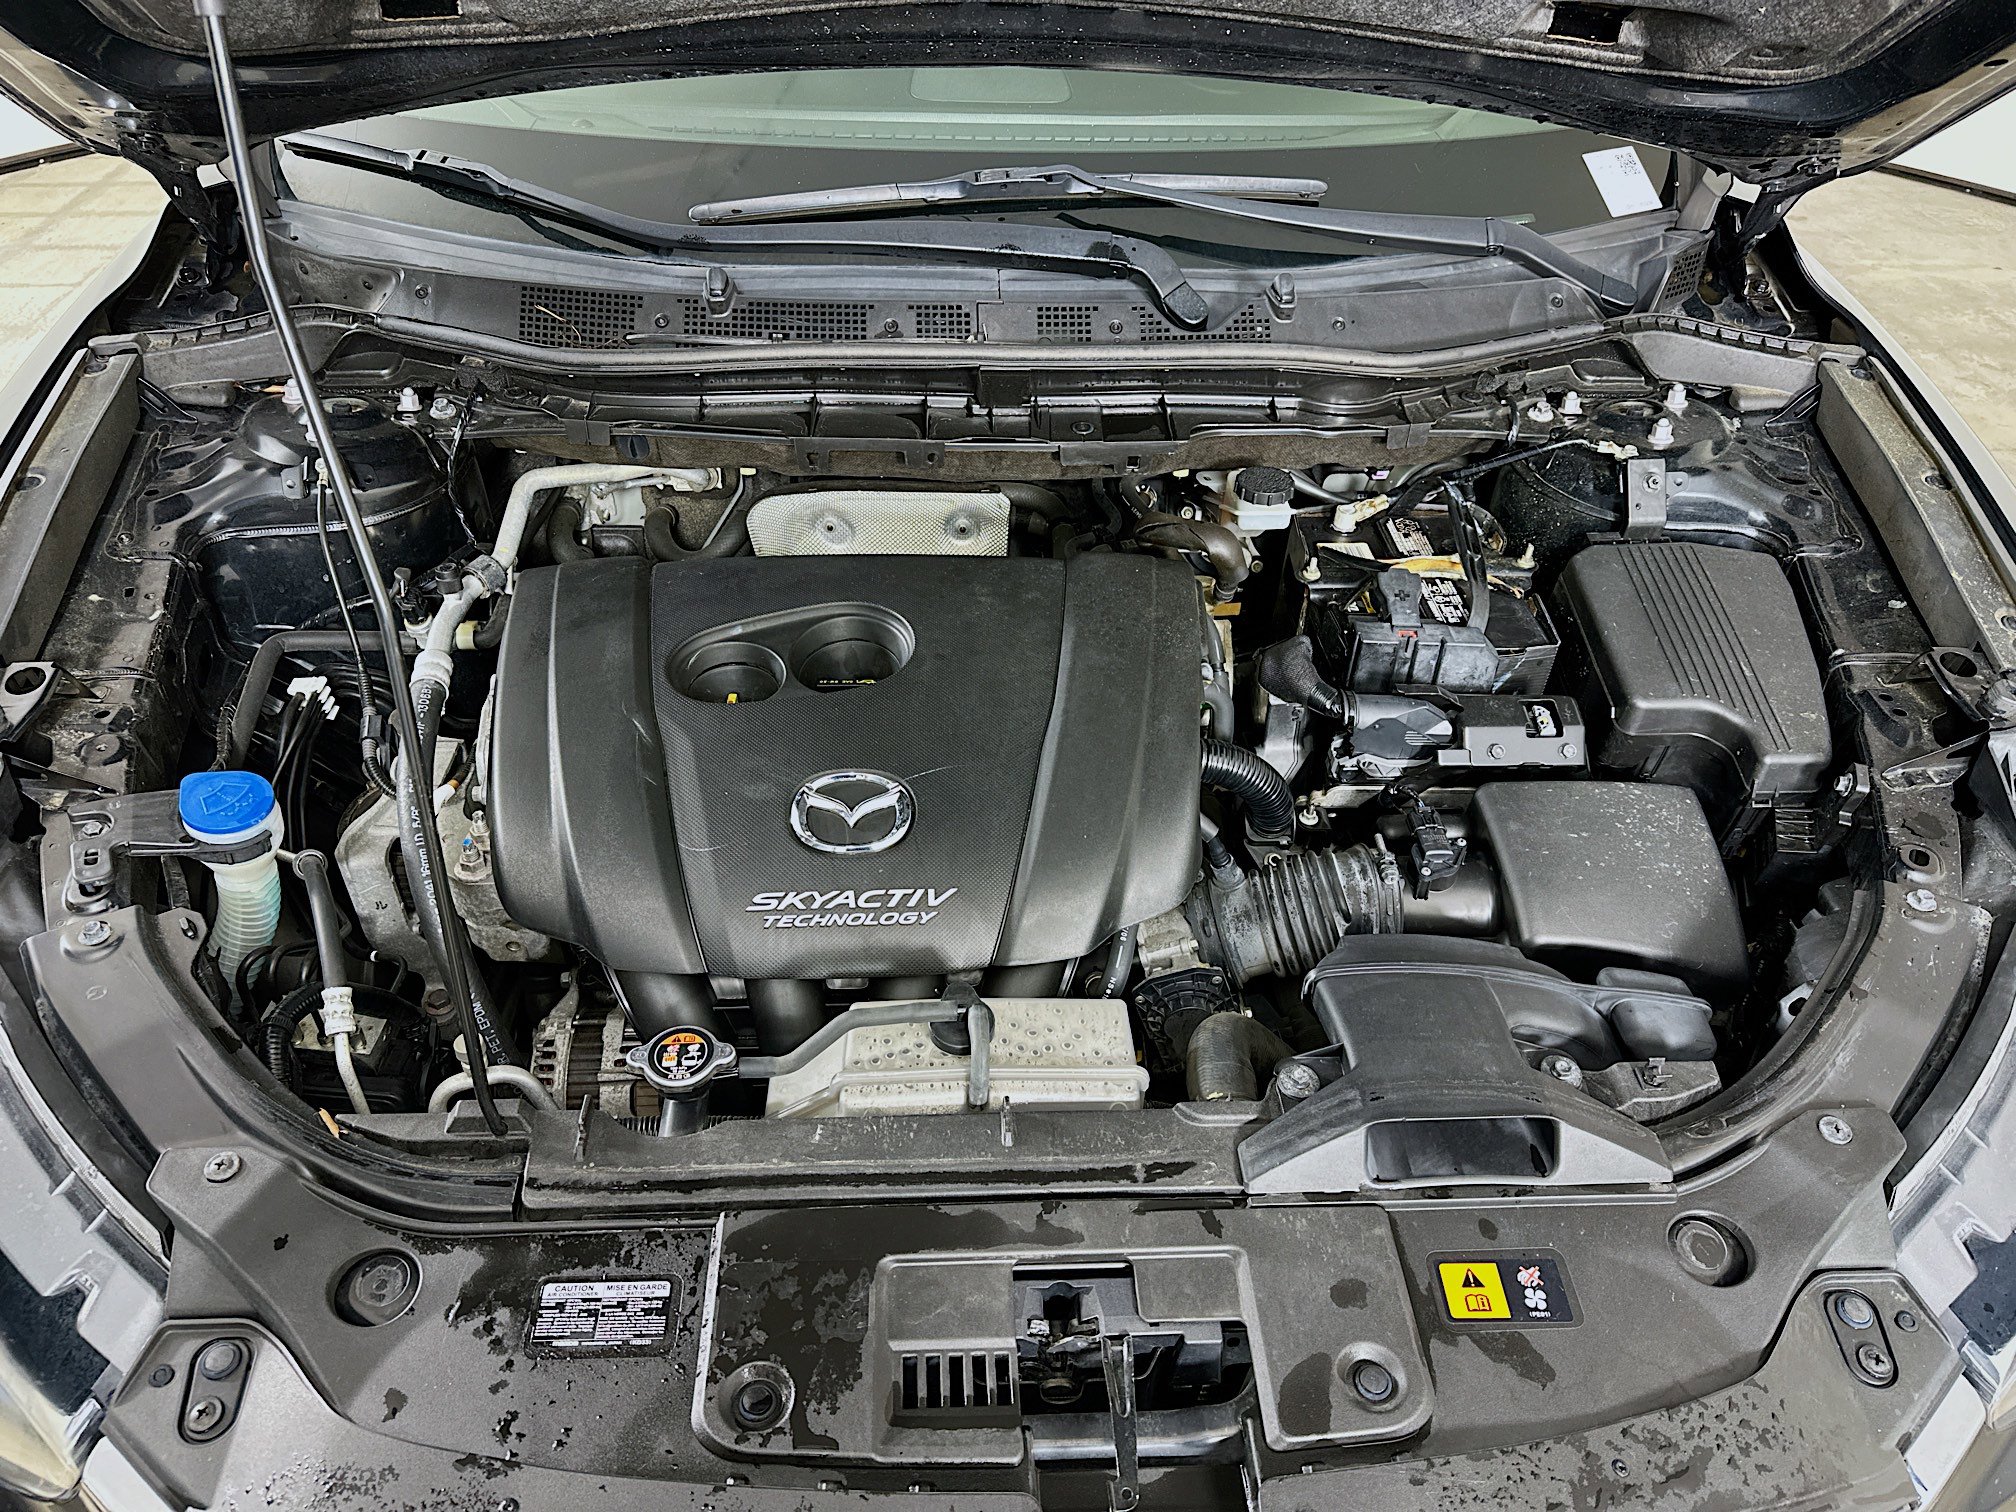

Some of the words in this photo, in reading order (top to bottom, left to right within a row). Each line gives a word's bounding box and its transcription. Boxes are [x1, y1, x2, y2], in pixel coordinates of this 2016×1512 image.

[745, 887, 959, 912] SKYACTIV
[763, 911, 939, 929] TECHNOLOGY
[472, 1001, 491, 1031] EPDM
[554, 1284, 595, 1292] CAUTION
[640, 1283, 668, 1291] GARDE
